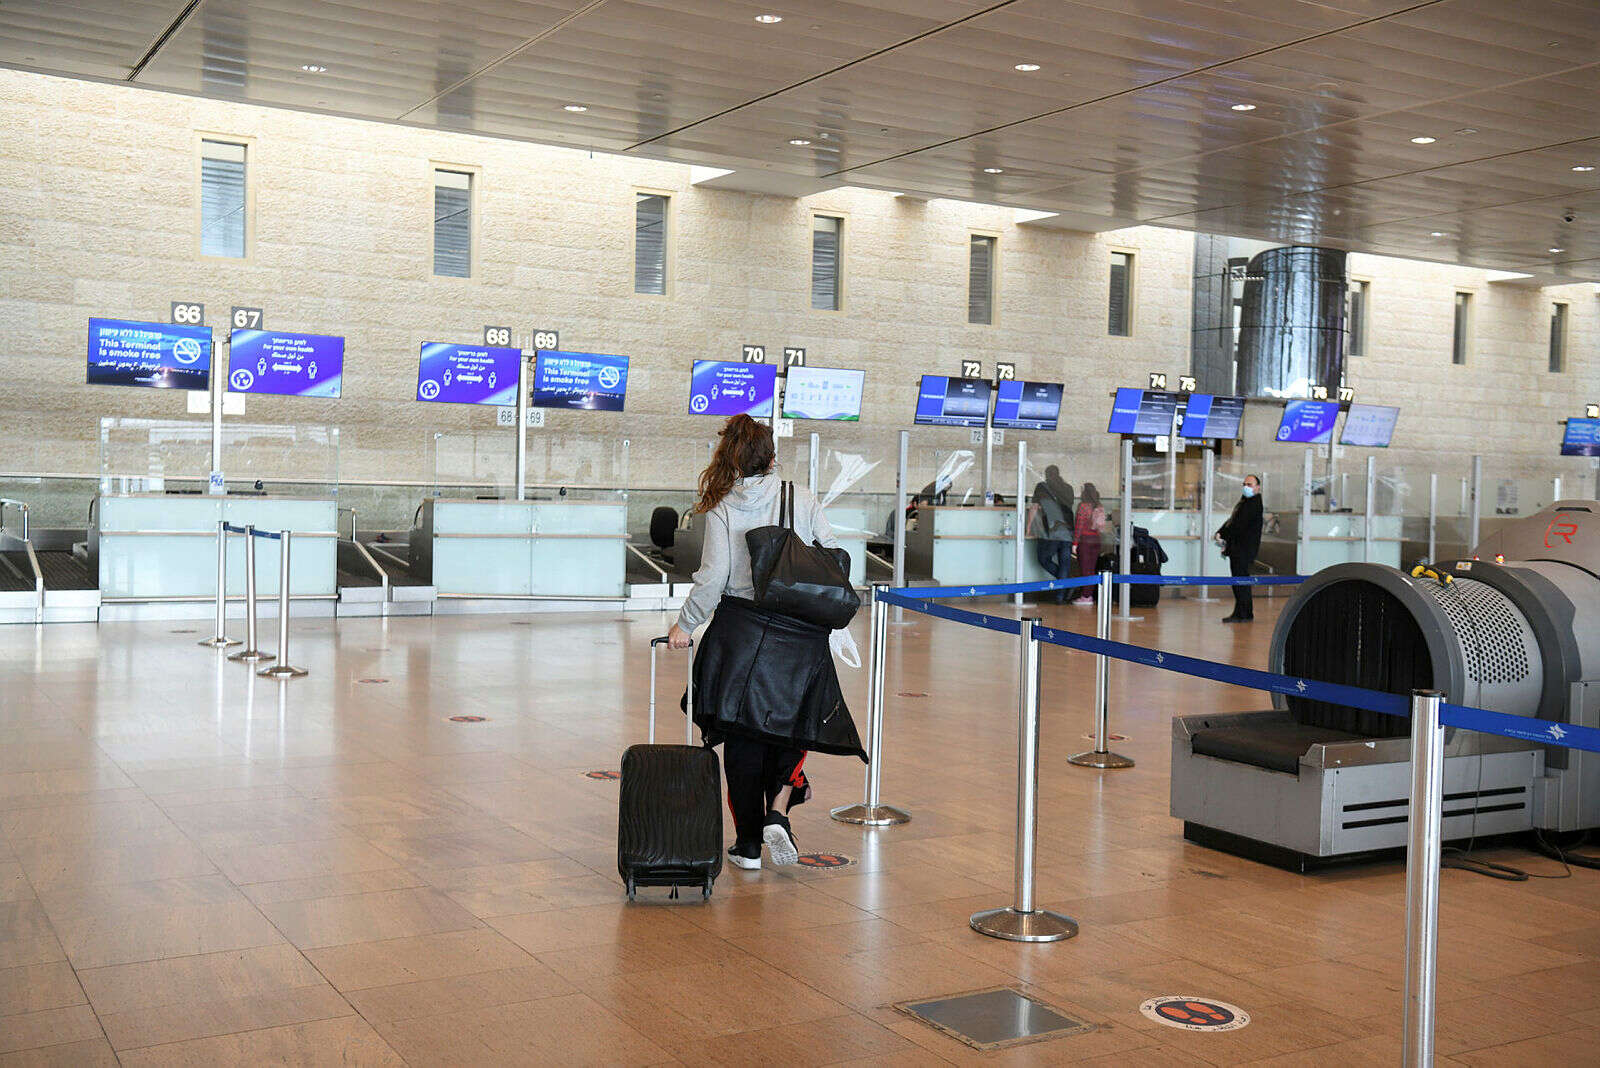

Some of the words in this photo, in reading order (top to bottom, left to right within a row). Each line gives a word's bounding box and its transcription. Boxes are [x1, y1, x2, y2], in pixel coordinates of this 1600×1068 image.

[173, 304, 201, 324] 66
[234, 309, 261, 328] 67
[486, 328, 510, 345] 68
[535, 332, 557, 349] 69
[99, 338, 119, 348] This
[120, 340, 161, 350] Terminal
[109, 349, 140, 358] smoke
[141, 350, 161, 359] free
[744, 347, 764, 363] 70
[786, 350, 804, 365] 71
[544, 367, 558, 375] This
[560, 368, 590, 377] Terminal
[963, 362, 981, 377] 72
[998, 365, 1014, 379] 73
[550, 376, 573, 384] smoke
[574, 376, 589, 384] free
[1150, 374, 1166, 388] 74
[1180, 377, 1196, 391] 75
[1340, 388, 1354, 401] 77
[501, 410, 512, 422] 68
[529, 412, 541, 424] 69
